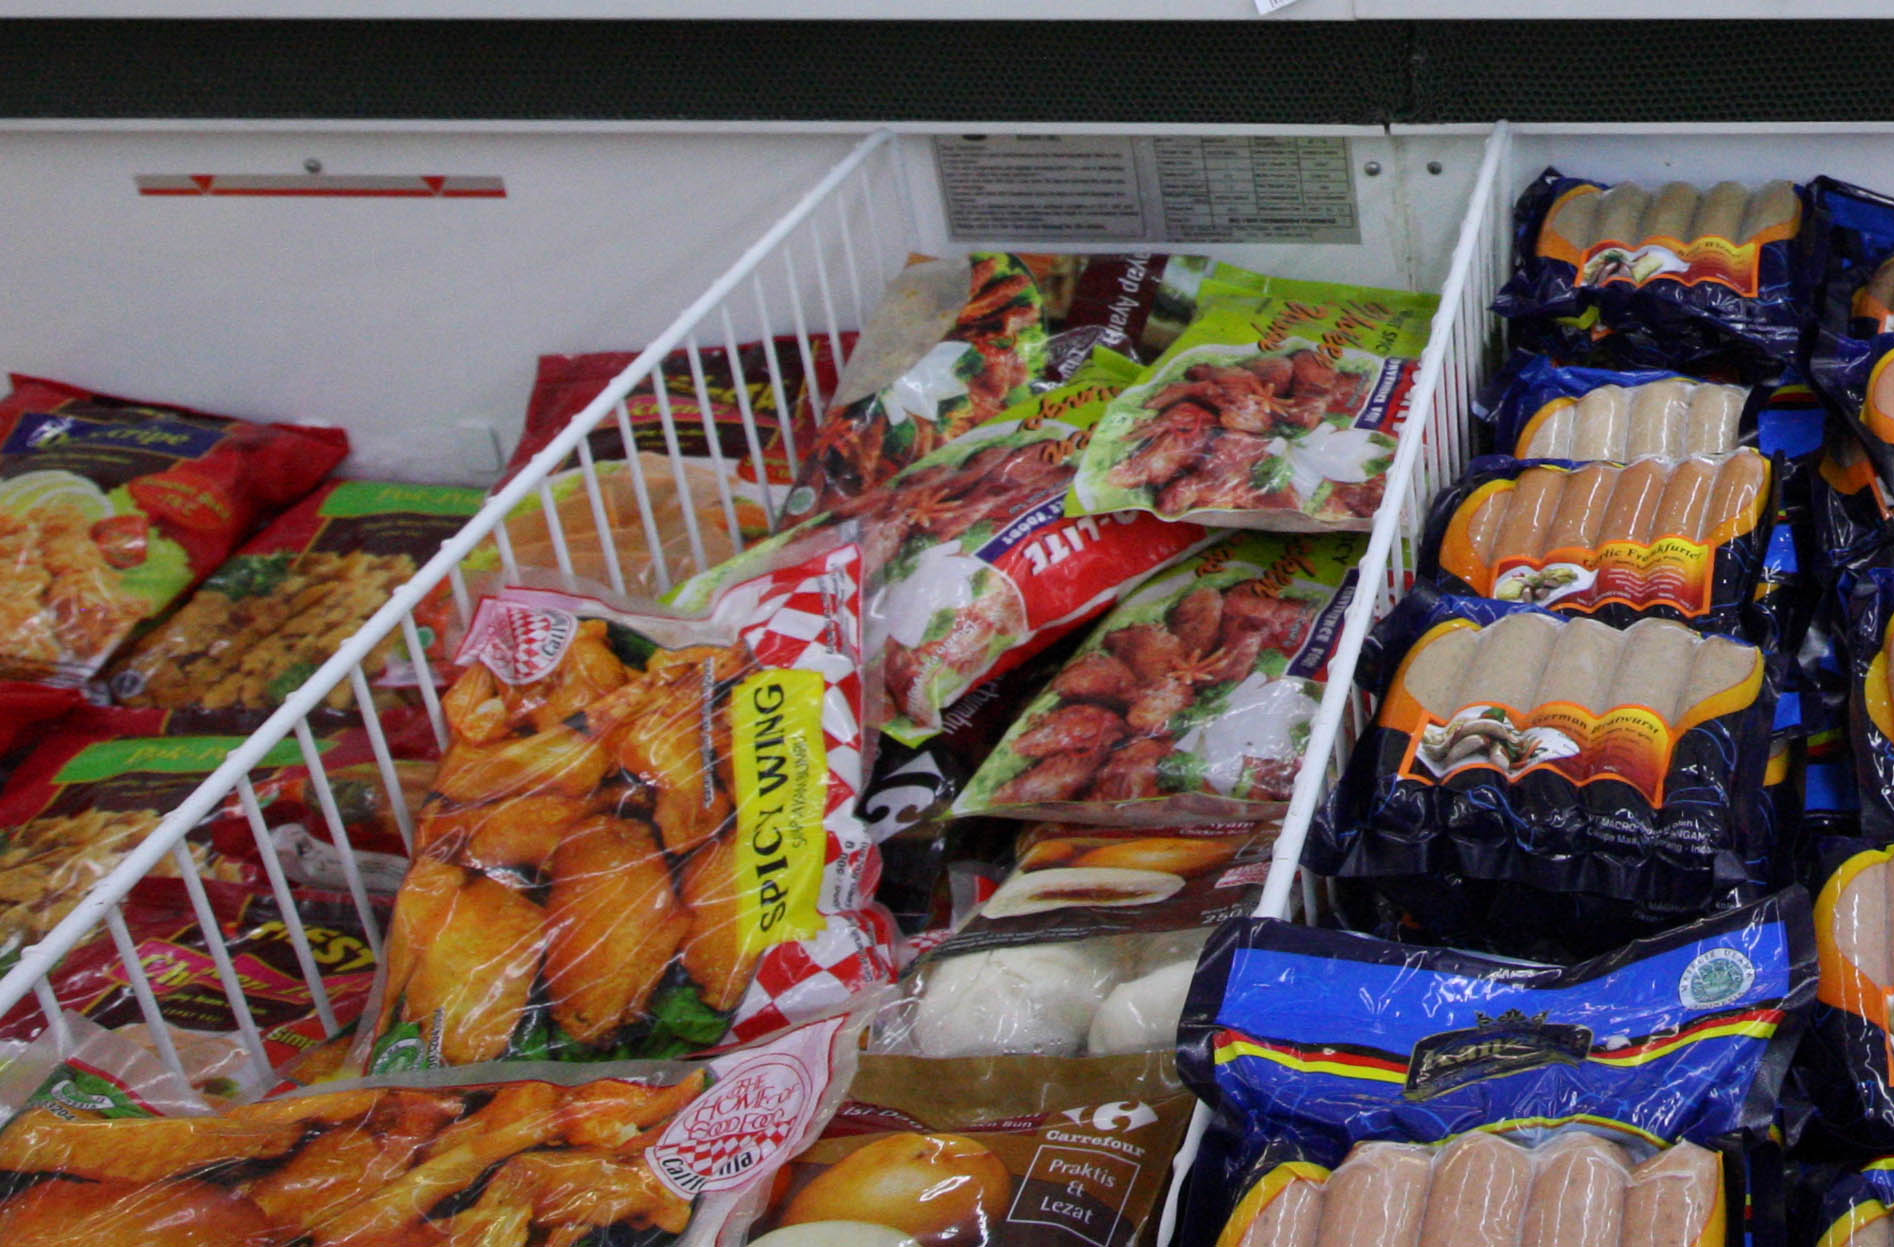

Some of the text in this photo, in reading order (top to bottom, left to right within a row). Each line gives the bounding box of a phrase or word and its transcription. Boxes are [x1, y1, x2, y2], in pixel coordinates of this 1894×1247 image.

[752, 681, 790, 935] SPICY WING
[1045, 1129, 1147, 1158] Carrefour
[1048, 1157, 1117, 1189] Praktis
[1066, 1178, 1085, 1198] &
[1039, 1195, 1094, 1225] Lezat
